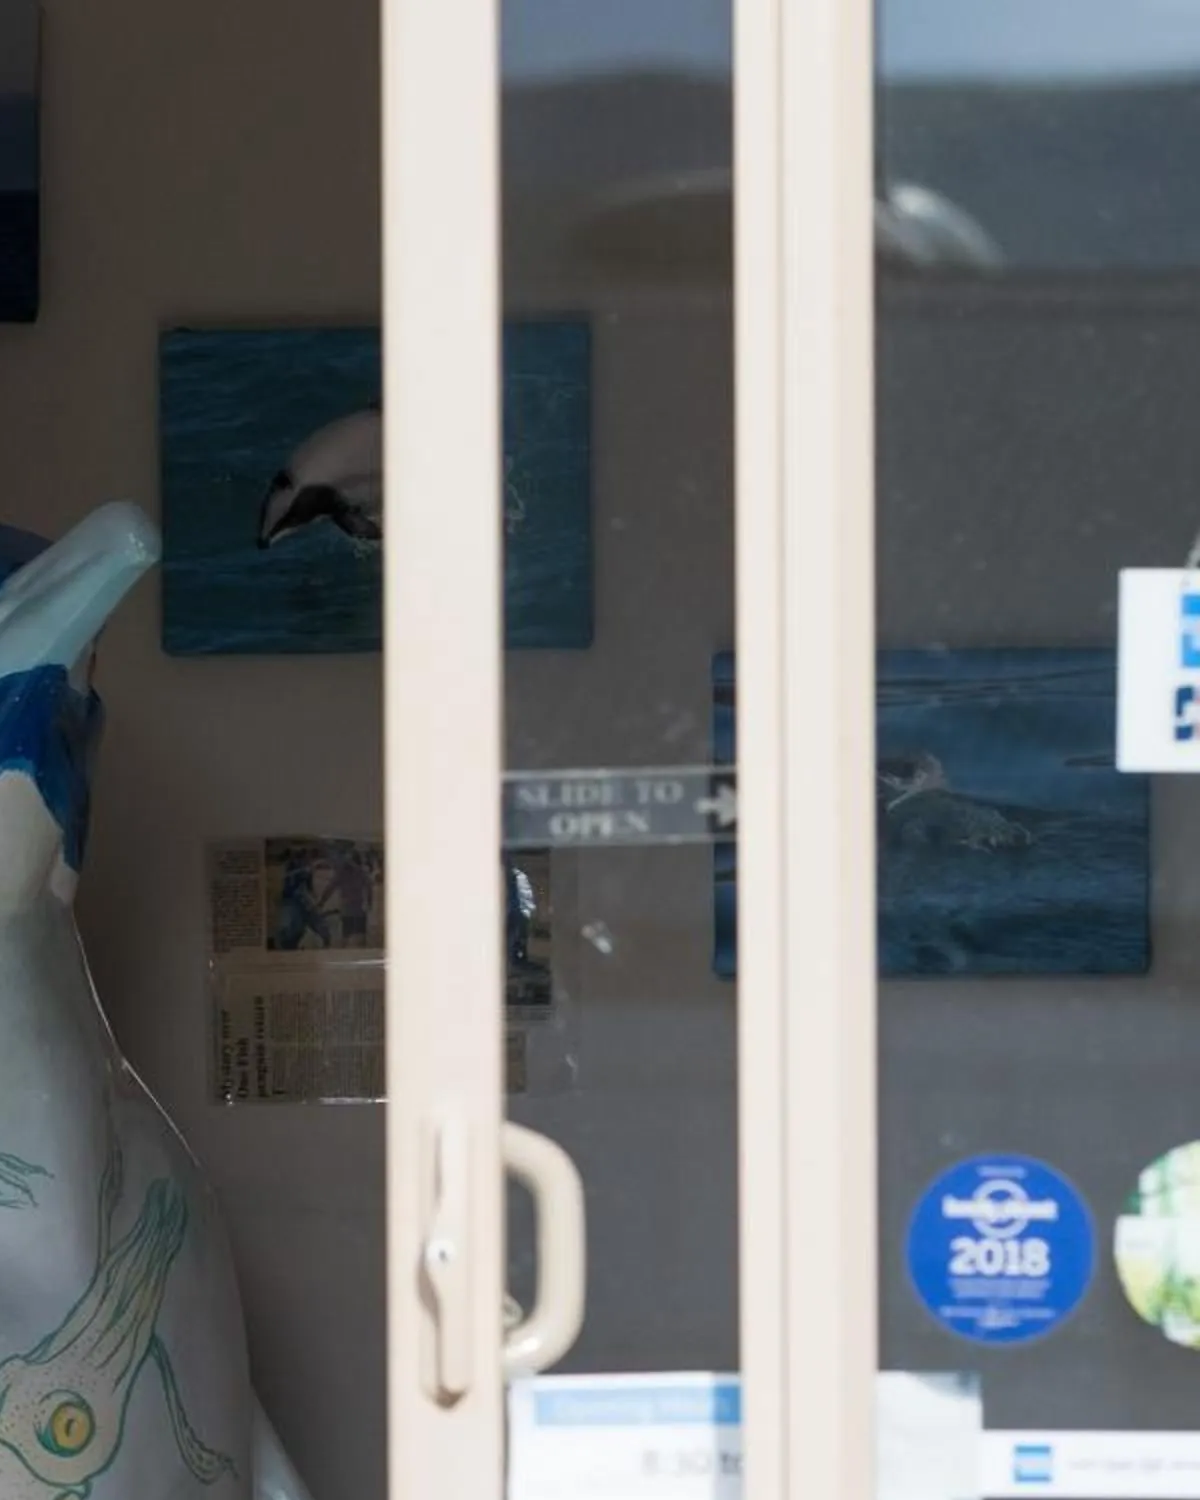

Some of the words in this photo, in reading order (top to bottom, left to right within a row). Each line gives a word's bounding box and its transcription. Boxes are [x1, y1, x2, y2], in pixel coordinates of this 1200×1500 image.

[516, 780, 621, 809] SLIDE
[634, 780, 685, 805] TO
[548, 810, 650, 838] OPEN
[949, 1237, 1050, 1276] 2018
